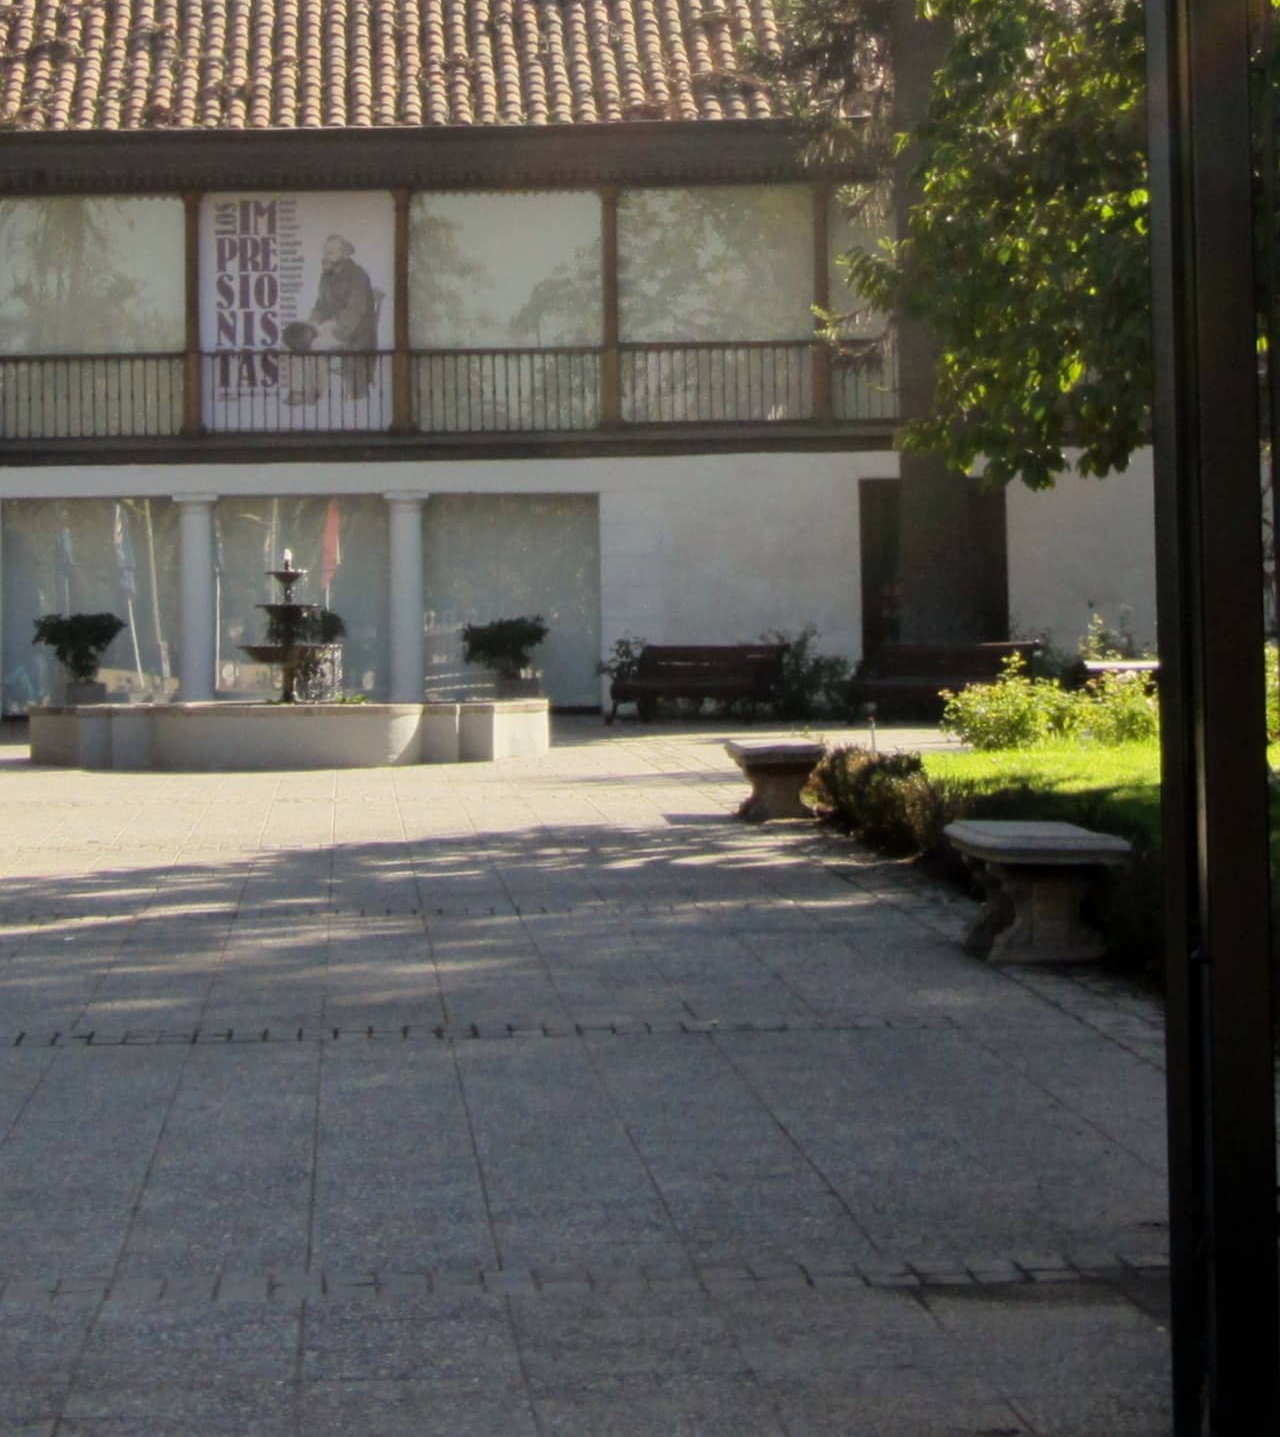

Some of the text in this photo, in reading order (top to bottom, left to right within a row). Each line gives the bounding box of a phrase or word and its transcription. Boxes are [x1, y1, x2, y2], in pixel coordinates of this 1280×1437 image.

[214, 203, 237, 237] LOS
[239, 199, 278, 237] IM
[216, 237, 279, 273] PRE
[216, 273, 279, 311] SIO
[216, 310, 280, 348] NIS
[216, 348, 280, 388] TAS
